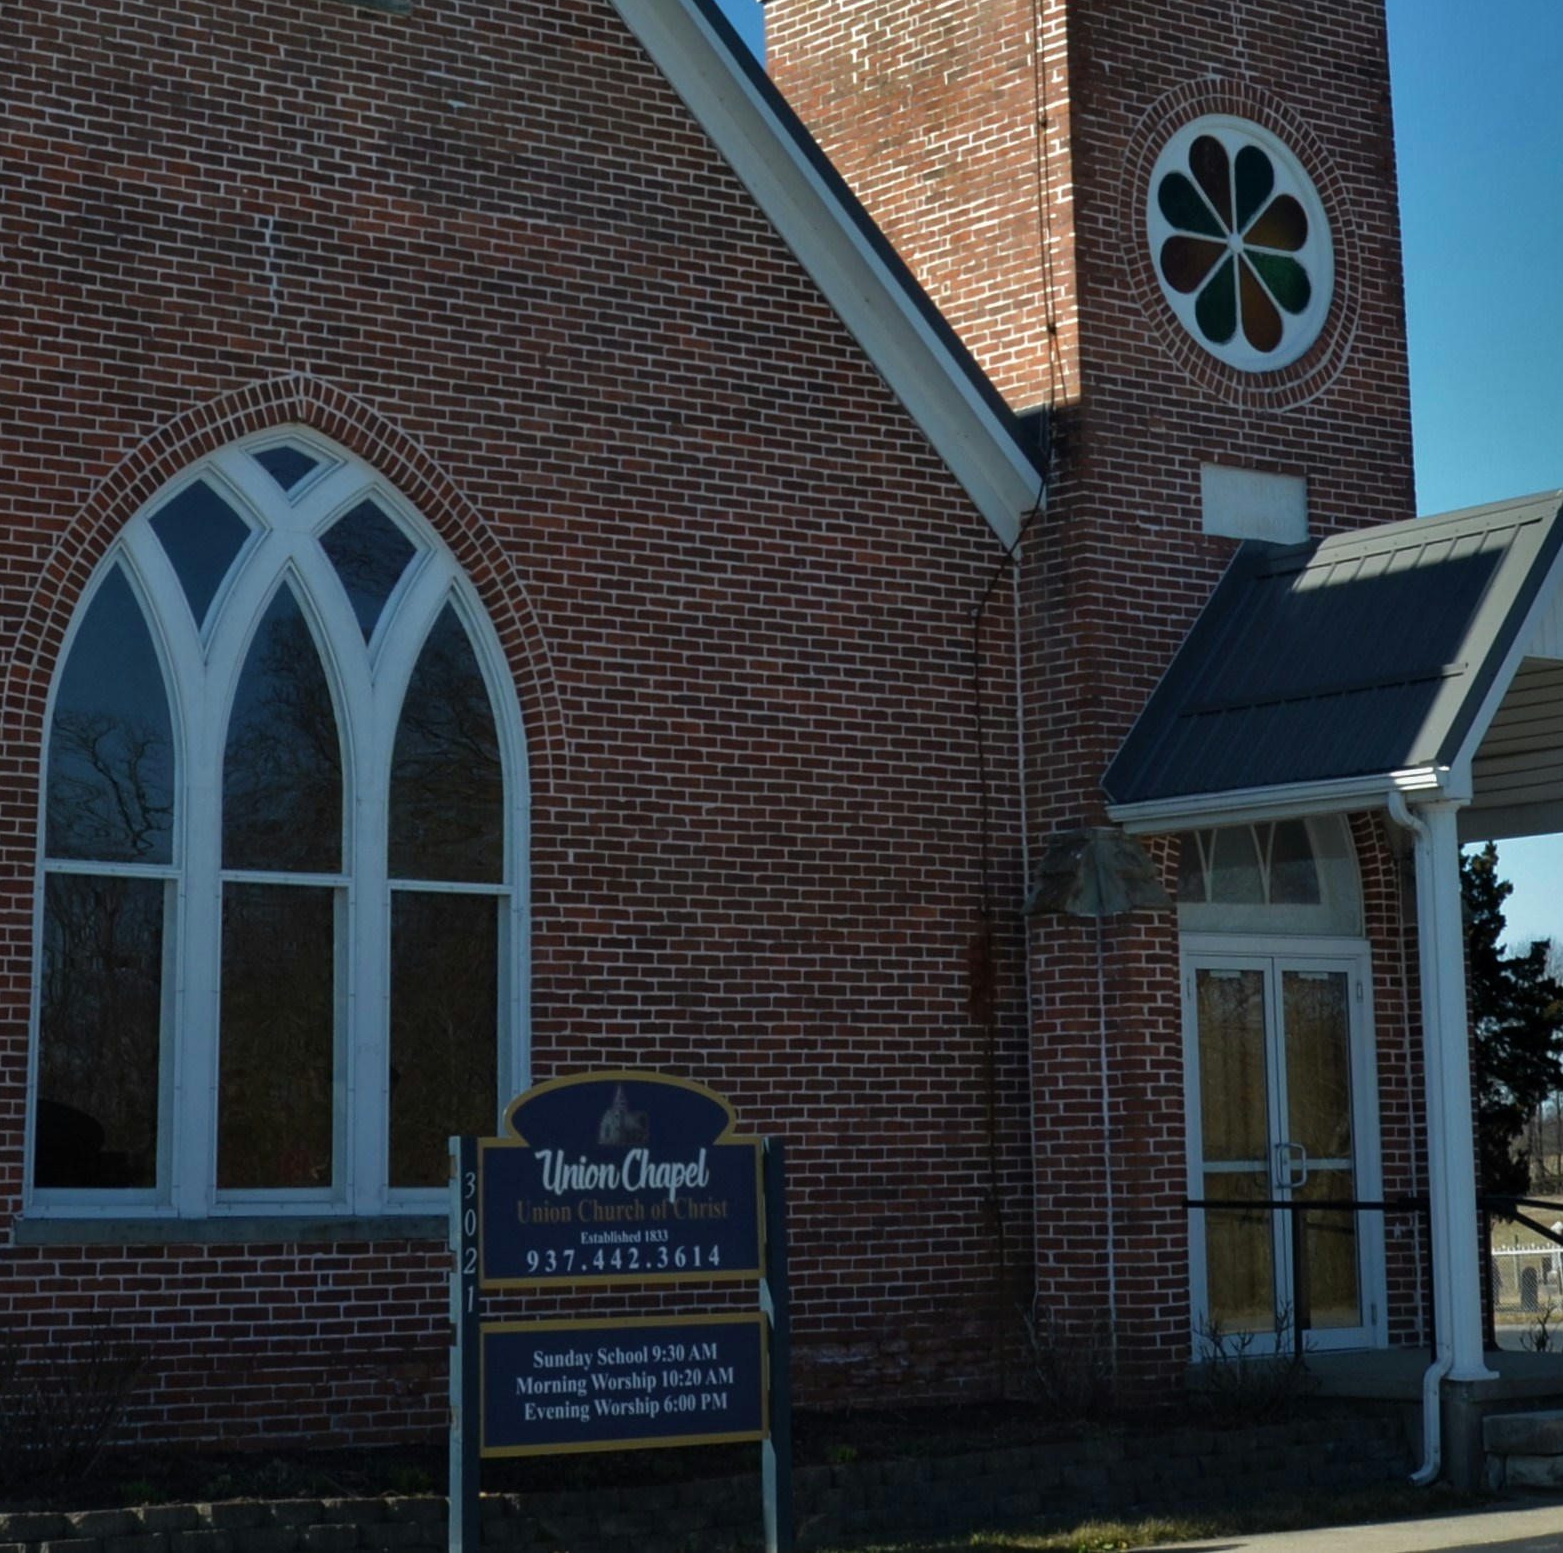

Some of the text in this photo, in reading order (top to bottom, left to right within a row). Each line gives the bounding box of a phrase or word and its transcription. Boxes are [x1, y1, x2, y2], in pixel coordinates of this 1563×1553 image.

[534, 1147, 709, 1204] Union Chapel
[516, 1197, 728, 1224] Union Church of Christ
[580, 1229, 669, 1245] Established 1833
[527, 1245, 721, 1273] 937.442.3614
[533, 1342, 718, 1371] Sunday School 9:30 AM
[516, 1367, 735, 1396] Morning Worship 10:20 AM
[524, 1392, 728, 1422] Evening Worship 6:00 PM
